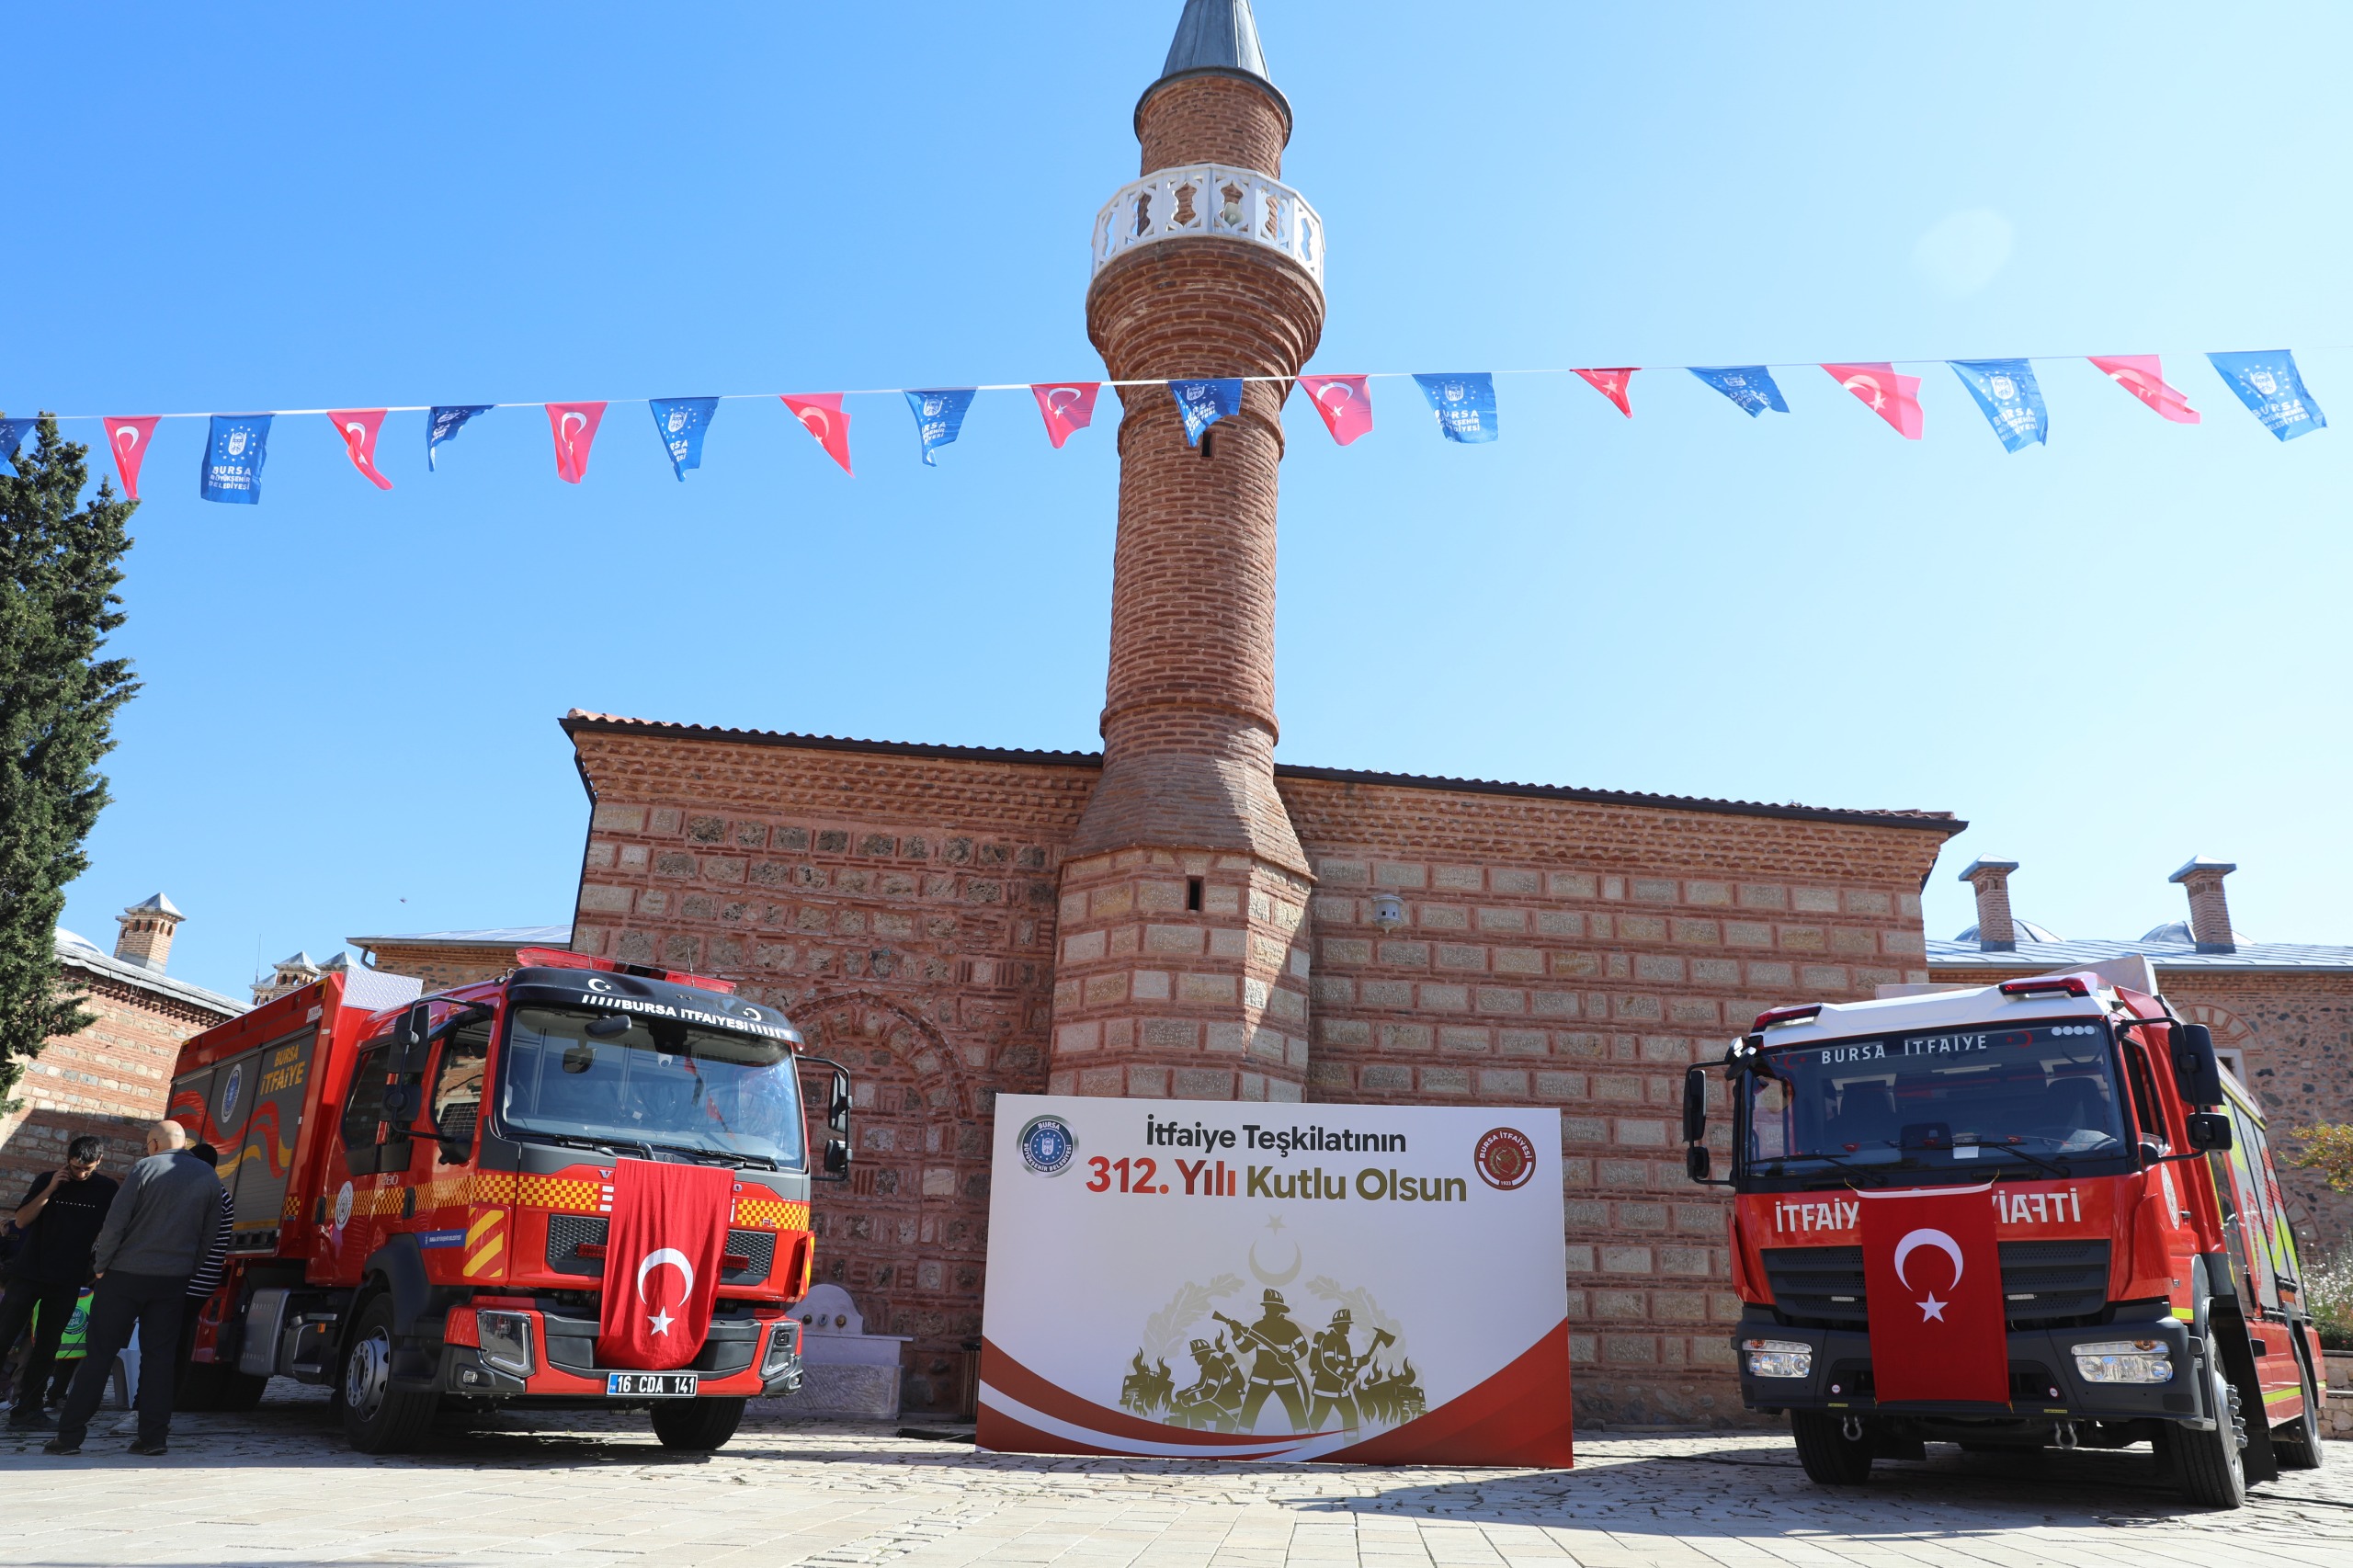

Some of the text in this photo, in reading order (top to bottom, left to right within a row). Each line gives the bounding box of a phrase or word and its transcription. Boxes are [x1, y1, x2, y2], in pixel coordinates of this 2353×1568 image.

[211, 465, 251, 475] BURSA
[620, 999, 677, 1017] BURSA
[274, 1044, 299, 1067] BURSA
[1822, 1035, 1987, 1064] BURSA İTFAİYE
[1038, 1121, 1061, 1131] BURSA
[1146, 1113, 1406, 1158] İtfaiye Teşkilatının
[1479, 1131, 1533, 1159] BURSA İTFAİYESİ
[1086, 1155, 1468, 1202] 312. Yılı Kutlu Olsun
[1775, 1198, 1859, 1233] İTFAİY
[618, 1375, 632, 1392] 16
[639, 1376, 664, 1393] CDA
[675, 1377, 695, 1393] 141
